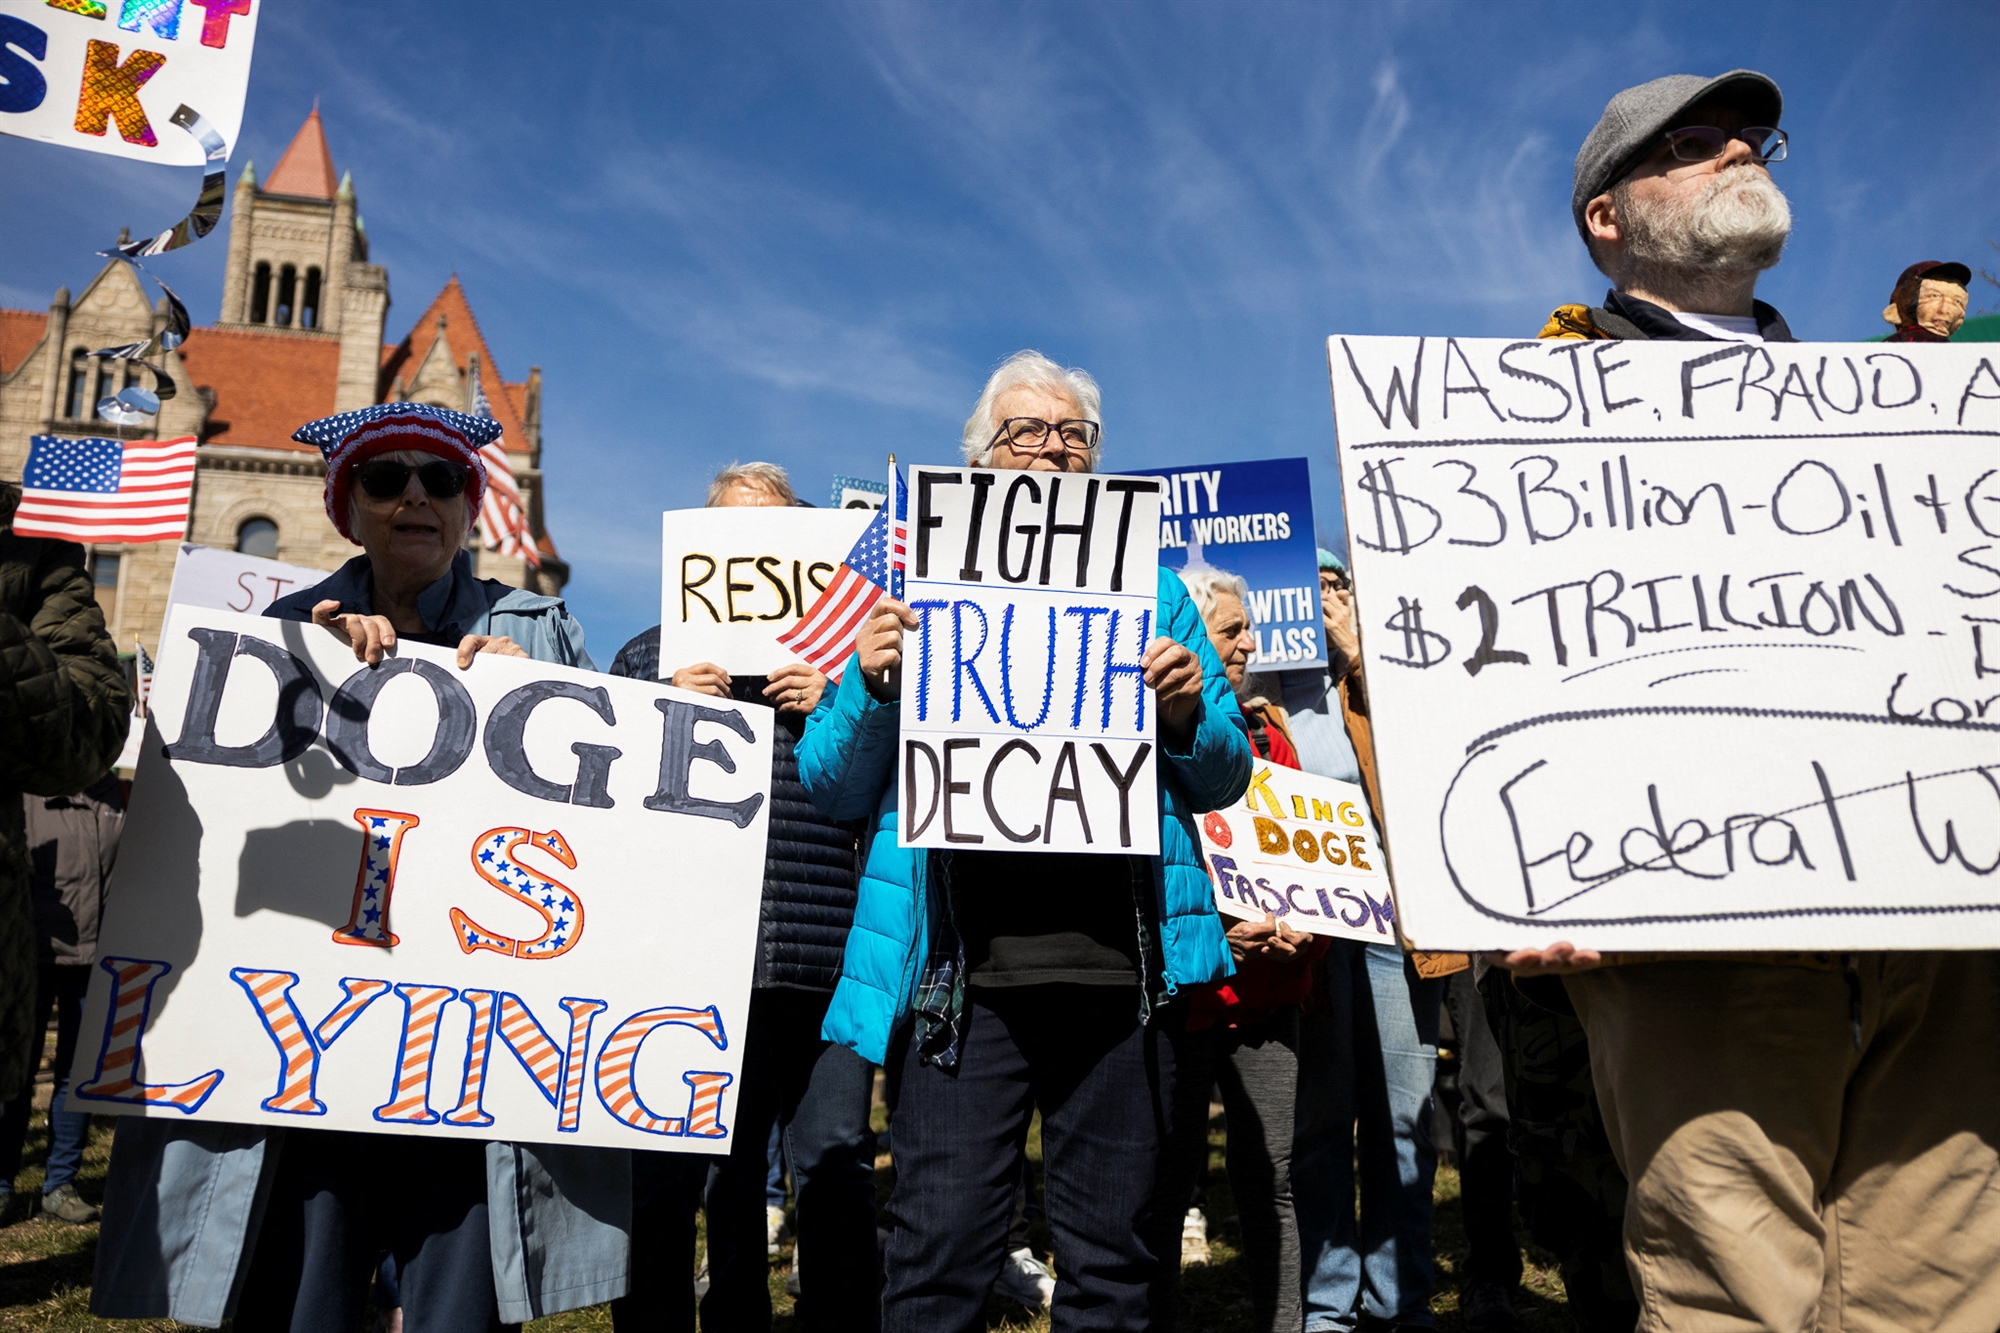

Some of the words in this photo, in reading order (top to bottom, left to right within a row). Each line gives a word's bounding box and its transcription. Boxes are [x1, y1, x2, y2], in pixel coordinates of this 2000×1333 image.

[44, 0, 251, 49] NT
[1681, 344, 1938, 422] FRAUD,
[916, 471, 1160, 592] FIGHT
[1159, 519, 1188, 550] AL
[1191, 512, 1291, 546] WORKERS
[227, 571, 316, 613] ST
[1248, 587, 1314, 625] WITH
[1380, 584, 1532, 677] $2
[1511, 569, 1905, 668] TRILLION
[908, 598, 1153, 733] TRUTH
[162, 627, 764, 828] DOGE
[906, 738, 1152, 848] DECAY
[1244, 766, 1365, 827] KING
[1499, 759, 1858, 909] Federal
[332, 808, 585, 960] IS
[1253, 816, 1373, 871] DOGE
[1209, 853, 1397, 935] FASCISM
[75, 956, 733, 1139] LYING
